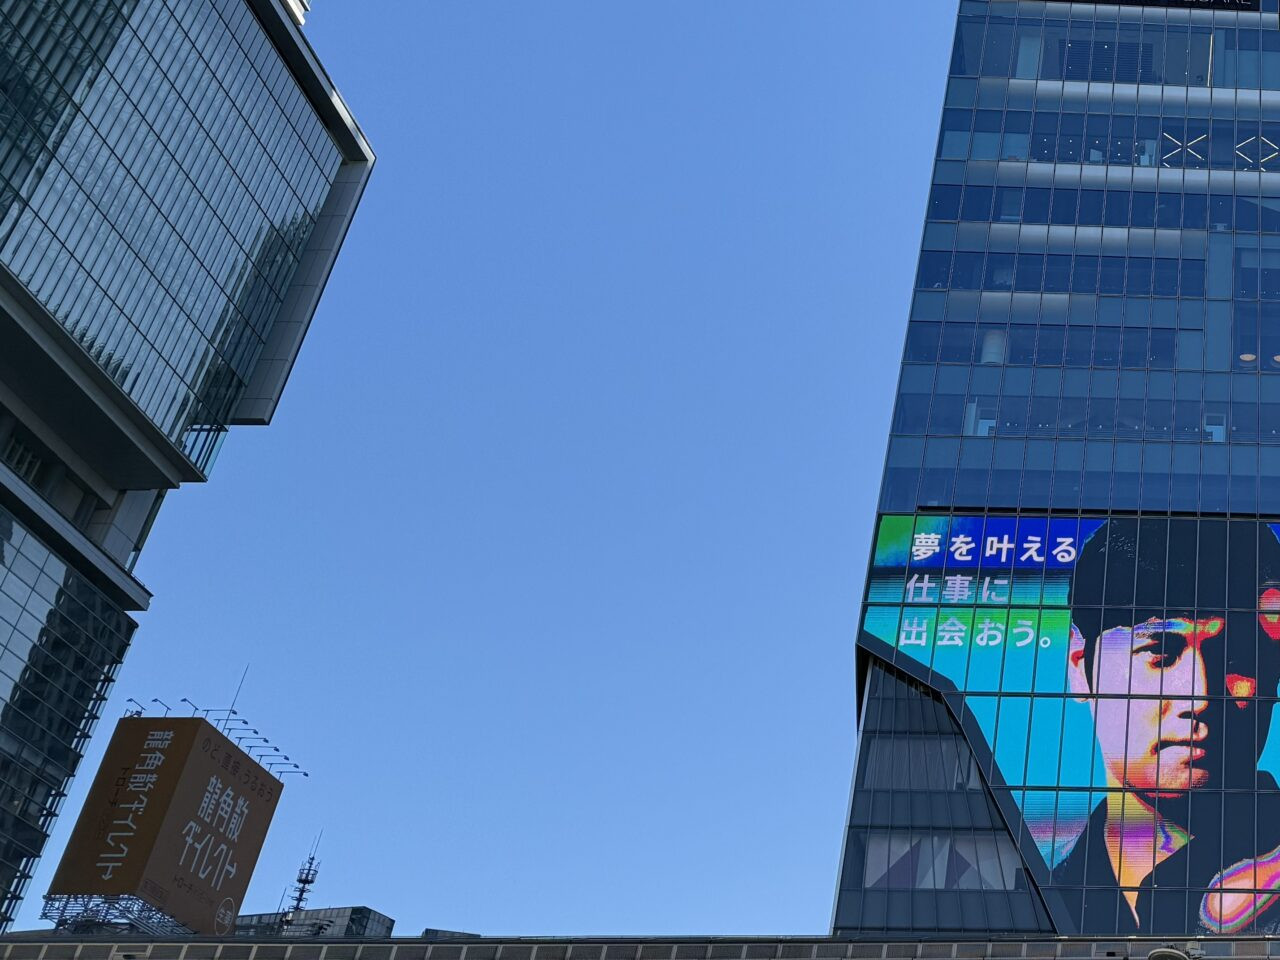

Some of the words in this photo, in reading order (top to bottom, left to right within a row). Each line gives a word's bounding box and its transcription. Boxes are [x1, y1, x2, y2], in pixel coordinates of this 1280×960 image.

[911, 532, 1077, 563] 夢を叶える
[906, 573, 1009, 603] 仕事に
[899, 616, 1051, 649] 出会おう。
